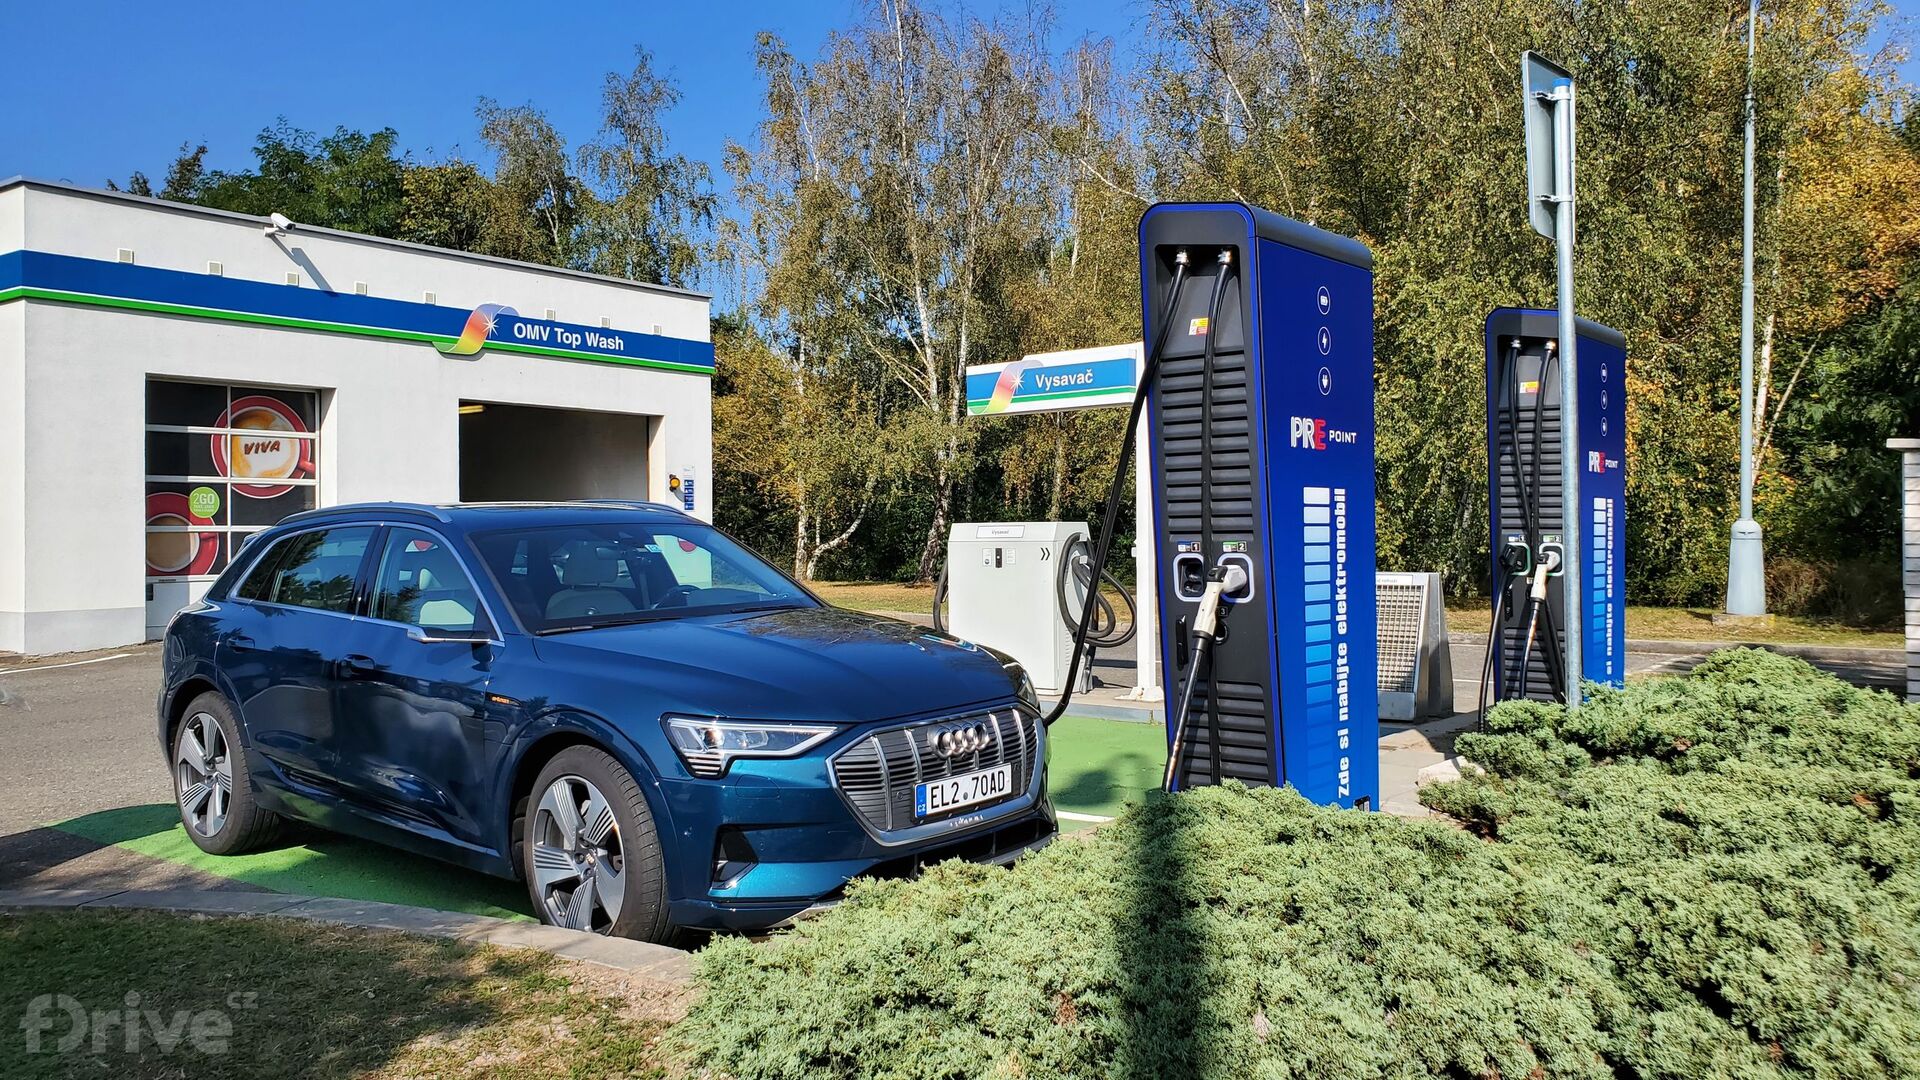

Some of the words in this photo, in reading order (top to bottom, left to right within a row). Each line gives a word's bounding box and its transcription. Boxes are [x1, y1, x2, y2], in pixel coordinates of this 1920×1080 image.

[513, 322, 551, 342] OMV
[554, 327, 582, 349] Top
[585, 331, 625, 351] Wash
[1035, 368, 1094, 391] Vysavač
[244, 439, 281, 455] VIVA
[1290, 416, 1327, 450] PRE
[1329, 429, 1357, 444] POINT
[1588, 450, 1605, 473] PRE
[193, 493, 215, 505] 2GO
[1334, 489, 1347, 634] elektromobil
[1336, 642, 1349, 721] nabijte
[1338, 729, 1348, 749] si
[930, 781, 960, 810] EL2
[971, 770, 1005, 800] 70AD
[1339, 757, 1350, 798] Zde
